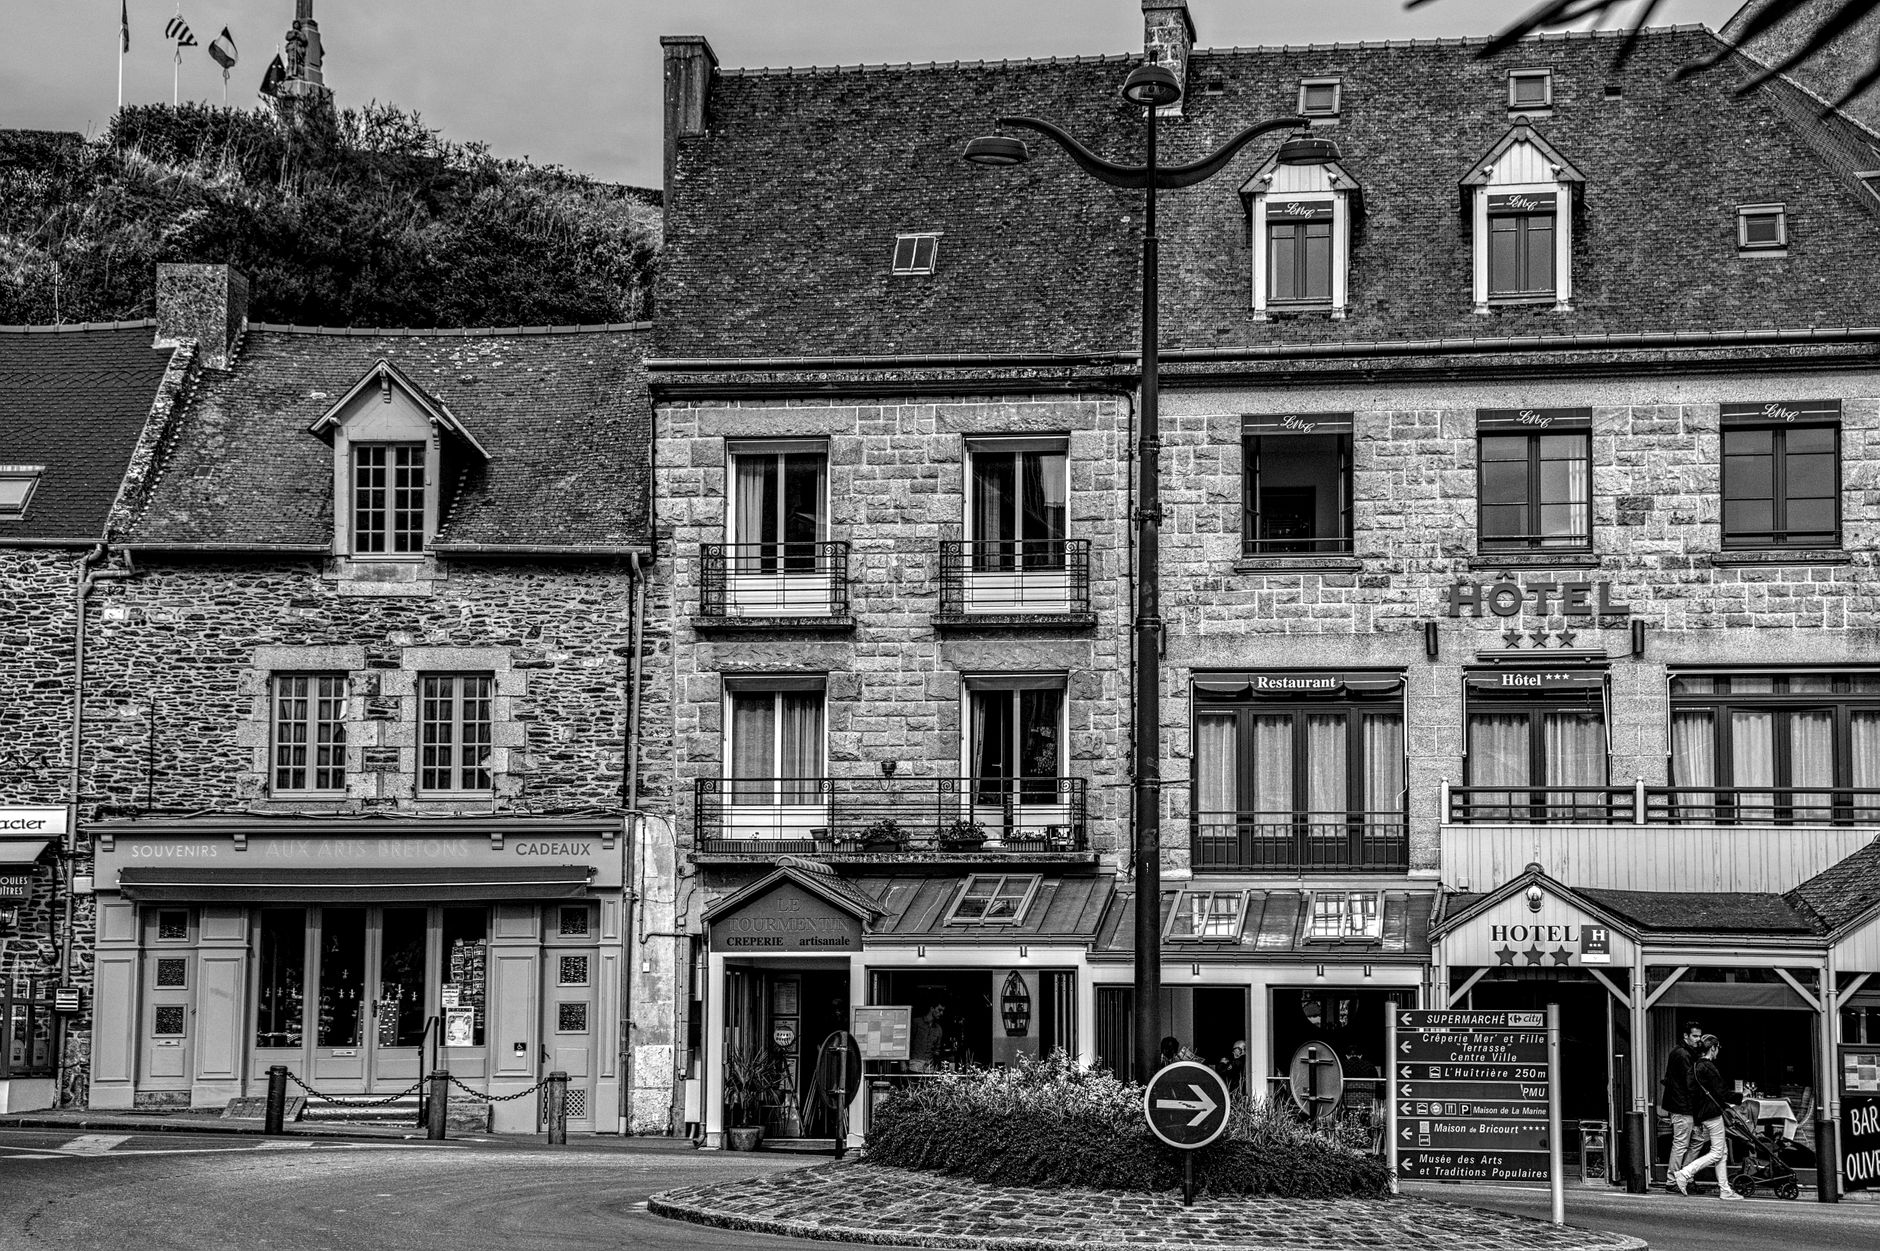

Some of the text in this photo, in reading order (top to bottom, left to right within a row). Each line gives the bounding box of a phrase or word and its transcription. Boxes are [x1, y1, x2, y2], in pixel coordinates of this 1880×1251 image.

[1449, 569, 1630, 617] HÔTEL
[1257, 676, 1336, 689] Restaurant
[1502, 673, 1542, 686] Hôtel
[131, 844, 218, 858] SOUVENIRS
[265, 839, 468, 858] AUX ARTS BRETONS
[515, 842, 591, 856] CADEAUX
[777, 898, 801, 913] LE
[727, 917, 850, 933] TOURMENTIN
[1490, 925, 1579, 942] HOTEL
[1592, 929, 1606, 942] H
[726, 935, 850, 947] CREPERIE artisanale
[1426, 1012, 1543, 1026] SUPERMARCHÉ city
[1422, 1033, 1468, 1044] Crêperie
[1503, 1035, 1514, 1043] et
[1519, 1034, 1545, 1044] Fille
[1450, 1052, 1518, 1062] Centre Ville
[1444, 1067, 1509, 1078] L'Huîtrière
[1522, 1087, 1546, 1097] PMU
[1473, 1105, 1498, 1114] Maison
[1500, 1106, 1509, 1114] de
[1511, 1106, 1520, 1115] La
[1522, 1107, 1547, 1115] Marine
[1850, 1105, 1880, 1136] BAR
[1434, 1123, 1467, 1133] Maison
[1479, 1123, 1519, 1134] Bricourt
[1418, 1153, 1503, 1165] Musée des Arts
[1419, 1166, 1549, 1179] et Traditions Populaires
